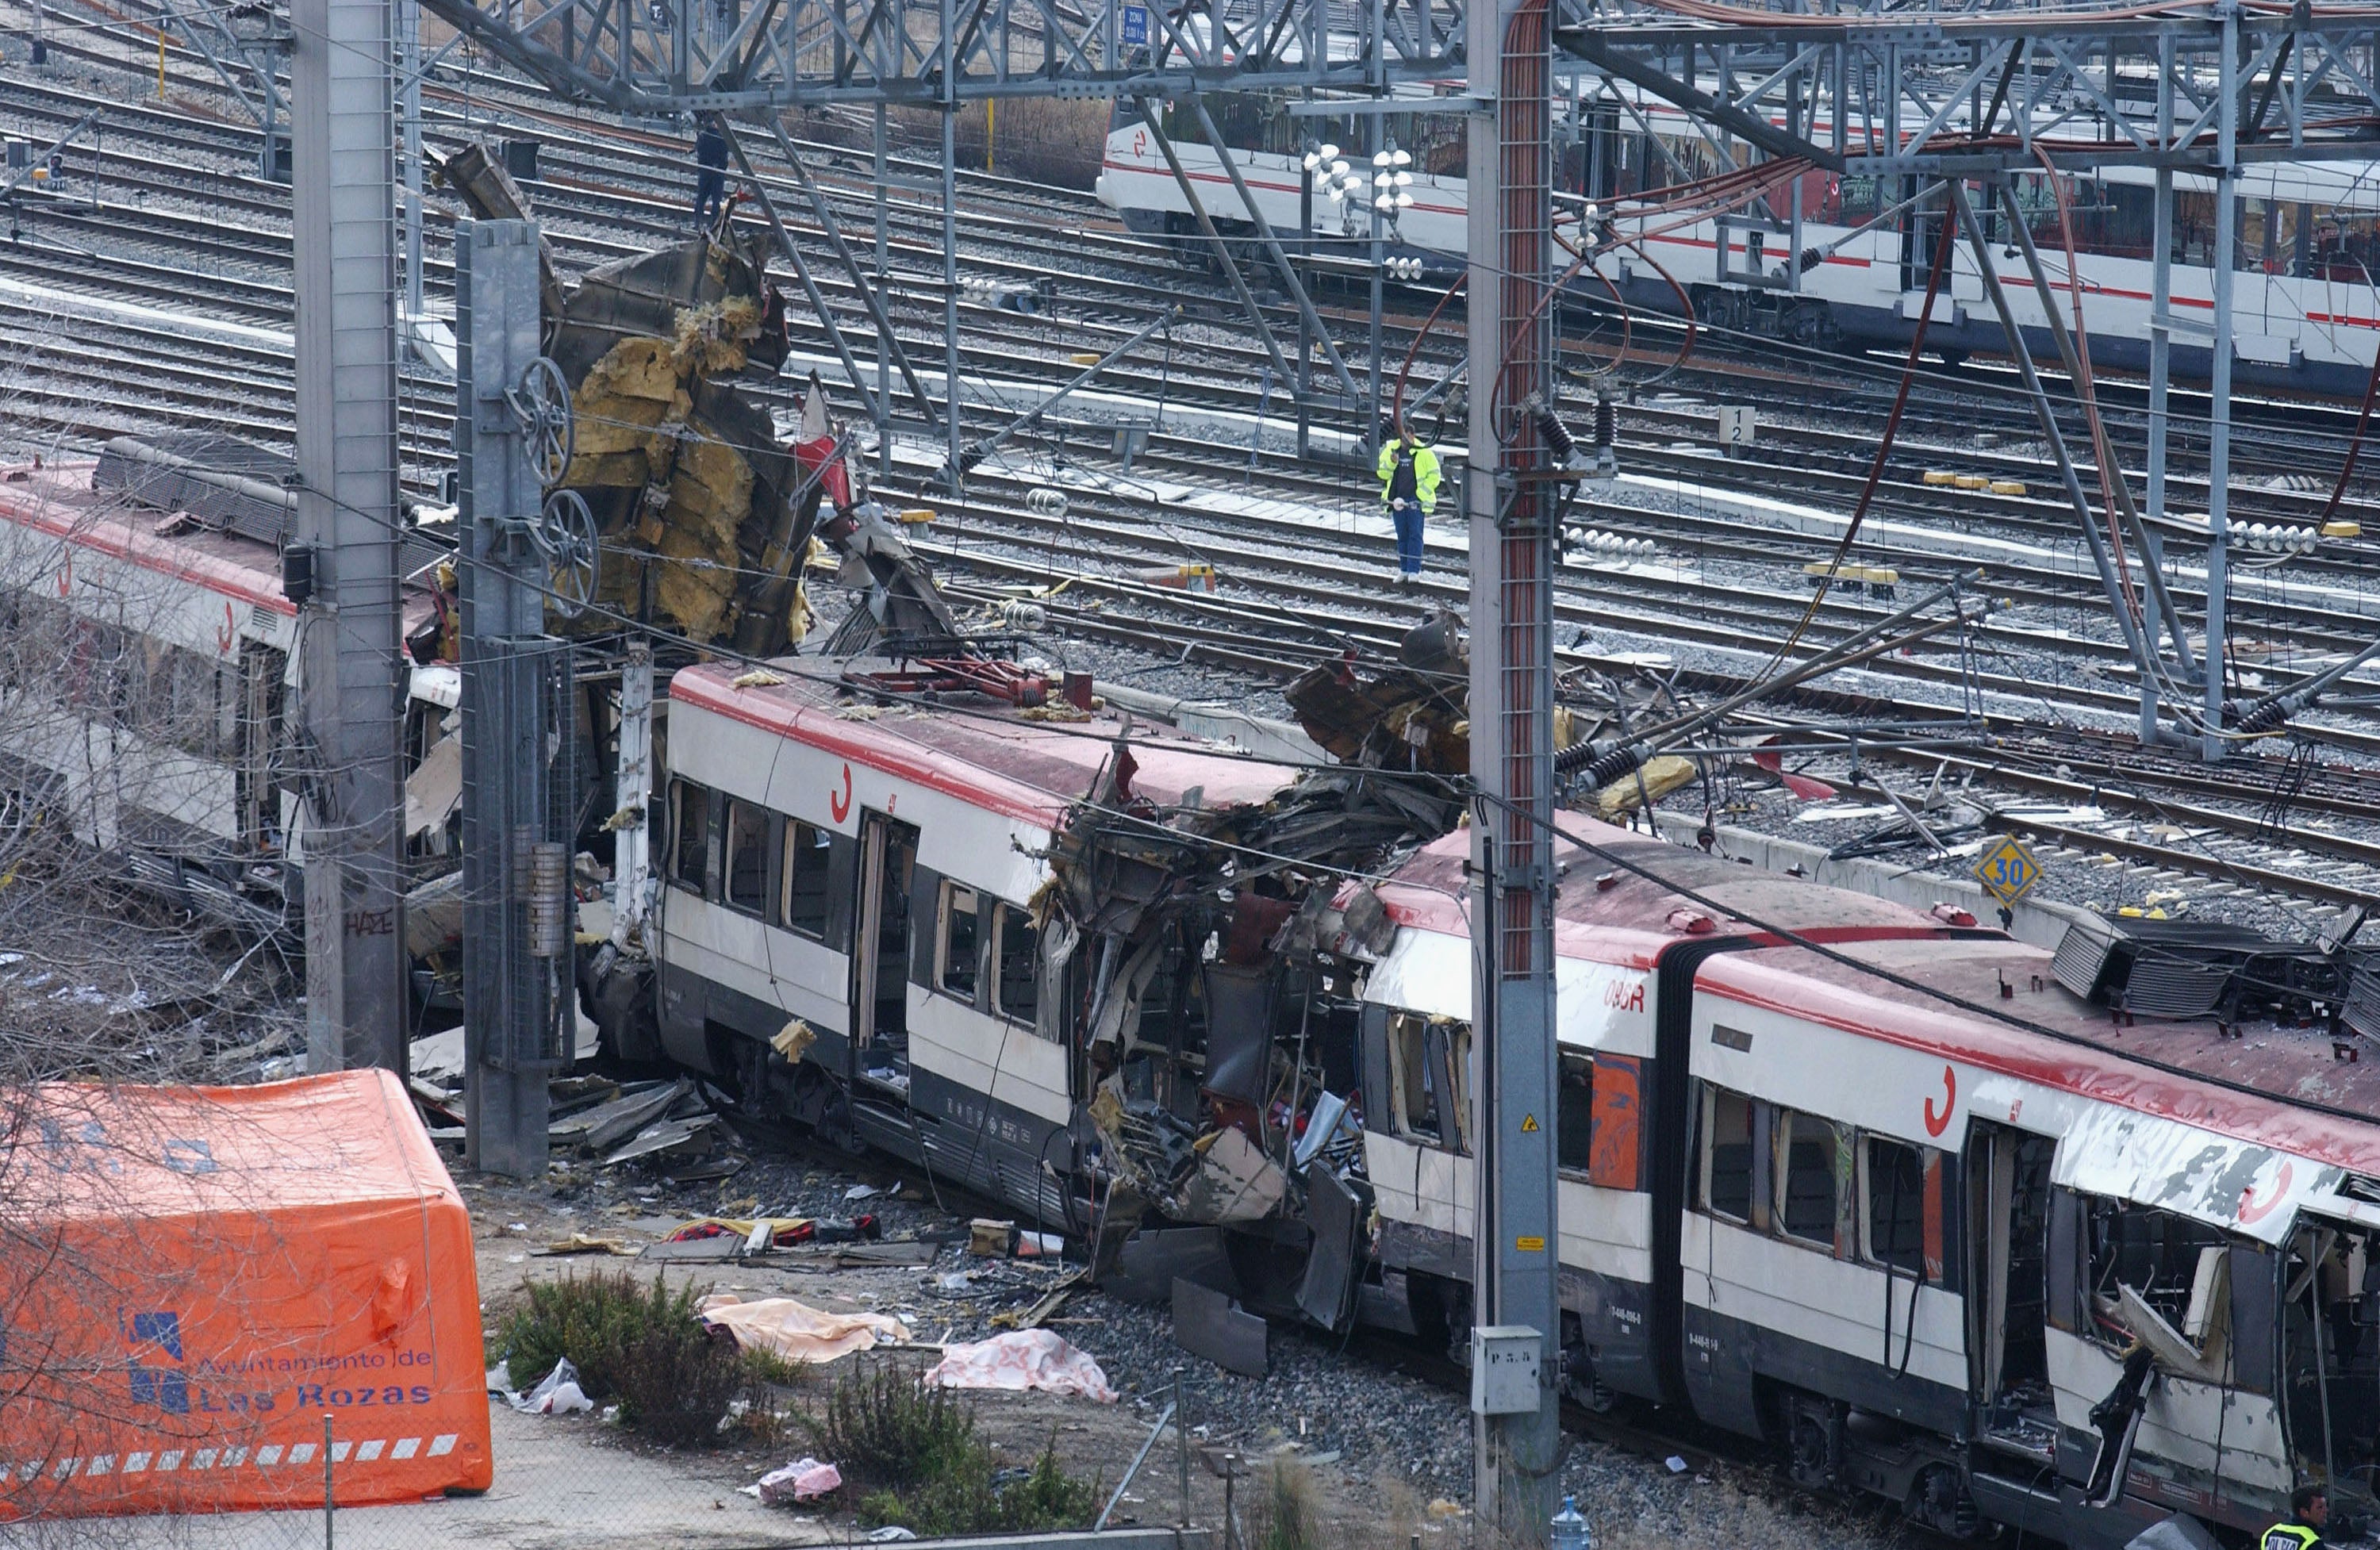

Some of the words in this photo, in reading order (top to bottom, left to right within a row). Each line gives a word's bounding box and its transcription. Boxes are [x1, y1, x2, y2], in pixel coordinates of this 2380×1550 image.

[1735, 409, 1741, 424] 1
[1733, 427, 1741, 441] 2
[1994, 857, 2024, 886] 30
[198, 1352, 386, 1374] Ayuntamiento
[398, 1349, 431, 1366] de
[201, 1388, 275, 1412] Las
[298, 1384, 431, 1407] Rozas
